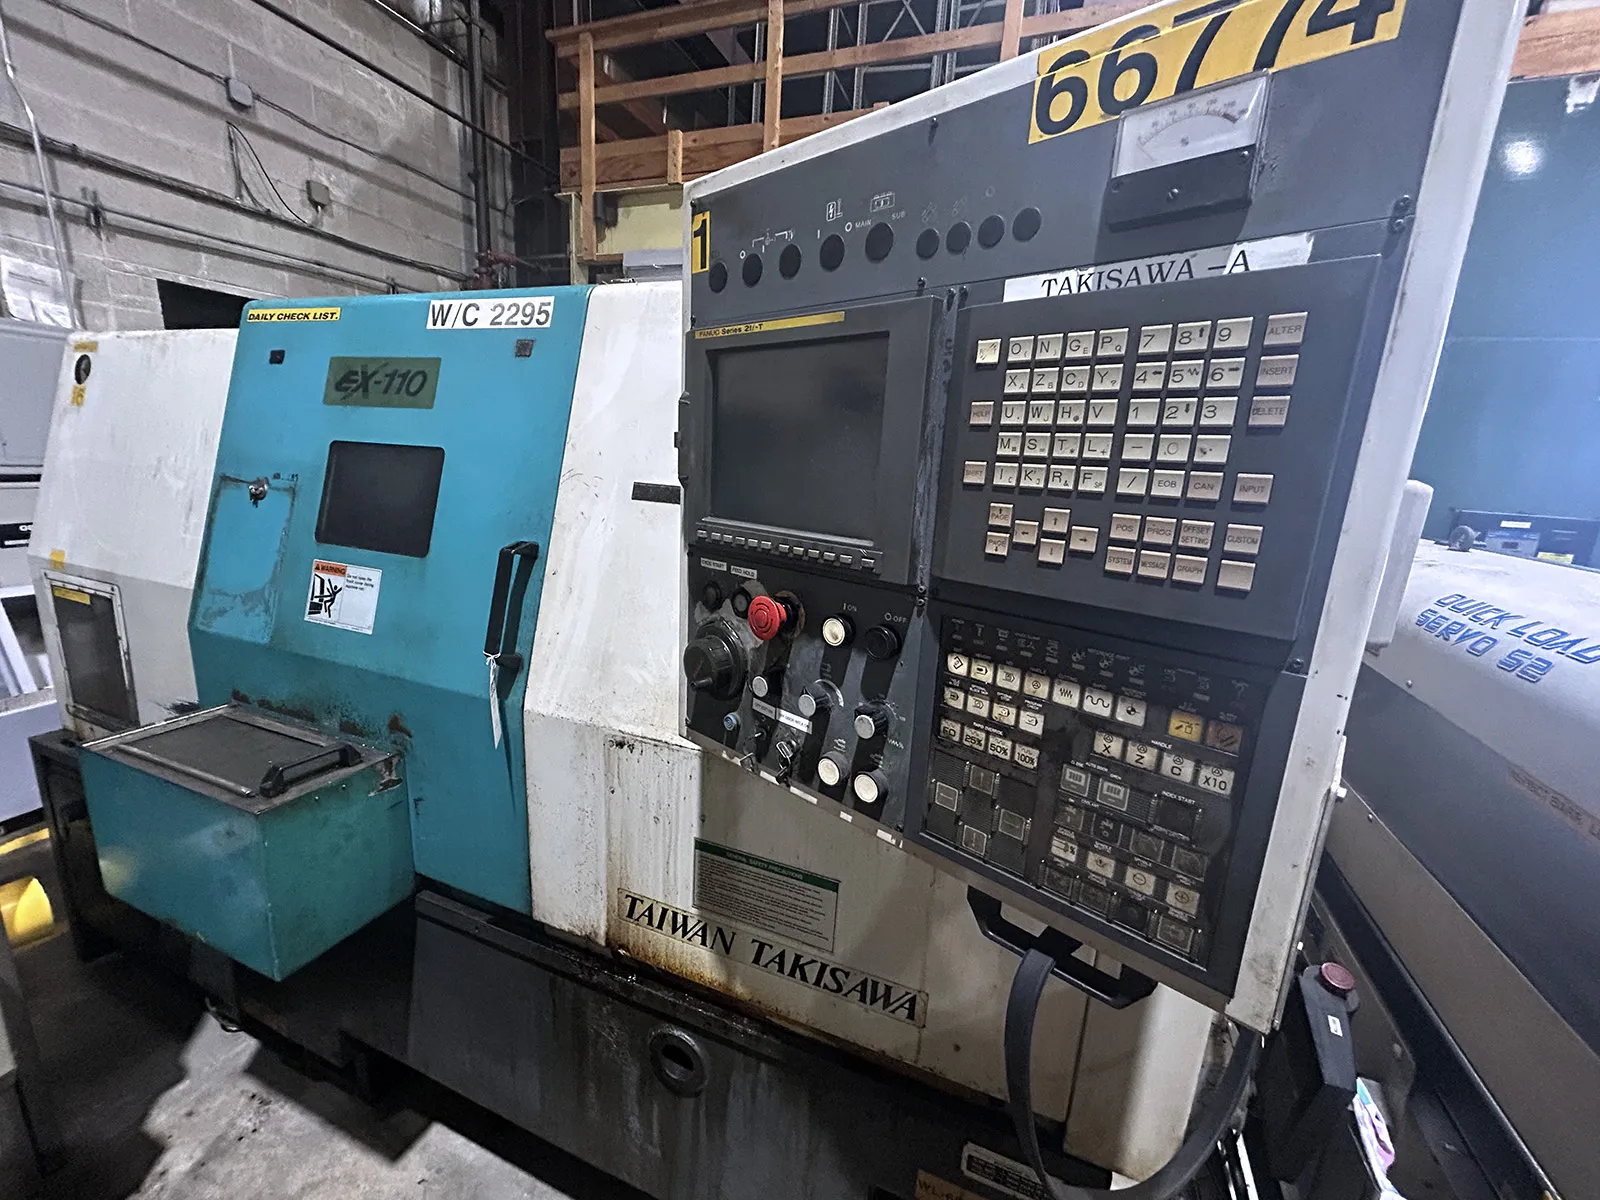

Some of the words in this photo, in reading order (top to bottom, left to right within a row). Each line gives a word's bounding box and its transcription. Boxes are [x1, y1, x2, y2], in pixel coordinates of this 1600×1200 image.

[891, 210, 906, 221] SUB
[855, 219, 872, 229] MAIN
[693, 216, 707, 271] 1
[1041, 257, 1195, 298] TAKISAWA
[248, 312, 276, 321] DAILY
[276, 312, 311, 321] CHECK
[312, 311, 339, 320] LIST.
[430, 303, 480, 328] W/C
[489, 301, 551, 326] 2295
[699, 328, 721, 338] FANUC
[721, 326, 742, 336] Series
[1218, 327, 1232, 342] 9
[1267, 324, 1302, 336] ALTER
[1099, 336, 1113, 350] P
[1142, 334, 1155, 348] 7
[1178, 330, 1193, 345] 8
[1039, 341, 1050, 354] N
[1069, 339, 1081, 352] G
[1097, 370, 1109, 384] Y
[1135, 370, 1148, 384] 4
[1171, 369, 1184, 383] 5
[1210, 367, 1224, 382] 6
[1259, 366, 1294, 376] INSERT
[335, 362, 428, 400] EX-110
[1007, 374, 1018, 387] X
[1035, 373, 1046, 386] Z
[1064, 372, 1076, 386] C
[1004, 406, 1014, 419] U
[1031, 406, 1043, 418] W
[1061, 406, 1072, 419] H
[1091, 405, 1104, 419] V
[1131, 406, 1139, 419] 1
[1165, 405, 1179, 420] 2
[1203, 404, 1217, 419] 3
[1251, 406, 1286, 416] DELETE
[1000, 437, 1011, 450] M
[1027, 438, 1037, 450] S
[1058, 438, 1067, 451] T
[1087, 440, 1097, 452] L
[1023, 469, 1033, 481] K
[1052, 471, 1062, 483] R
[1082, 472, 1093, 484] F
[1157, 479, 1177, 488] EOB
[1193, 481, 1215, 491] CAN
[1238, 485, 1265, 494] INPUT
[990, 512, 1009, 521] PAGE
[1115, 524, 1134, 532] POS
[1146, 527, 1172, 537] PROG
[1182, 525, 1210, 535] OFFSET
[988, 538, 1007, 547] PAGE
[1180, 536, 1209, 546] SETTING
[1227, 535, 1259, 545] CUSTOM
[1108, 555, 1133, 565] SYSTEM
[1140, 560, 1167, 570] MESSAGE
[320, 564, 346, 575] WARNING
[1176, 564, 1203, 574] GRAPH
[1434, 593, 1526, 630] QUICK
[892, 615, 907, 624] OFF
[1415, 608, 1498, 657] SERVO
[1496, 648, 1555, 684] S2
[964, 734, 983, 747] 25%
[989, 742, 1009, 756] 50%
[1102, 743, 1111, 754] X
[1017, 752, 1035, 767] 100%
[1134, 754, 1145, 765] Z
[1170, 766, 1182, 778] C
[1203, 775, 1228, 791] X10
[624, 893, 737, 956] TAIWAN
[750, 938, 920, 1021] TAKISAWA
